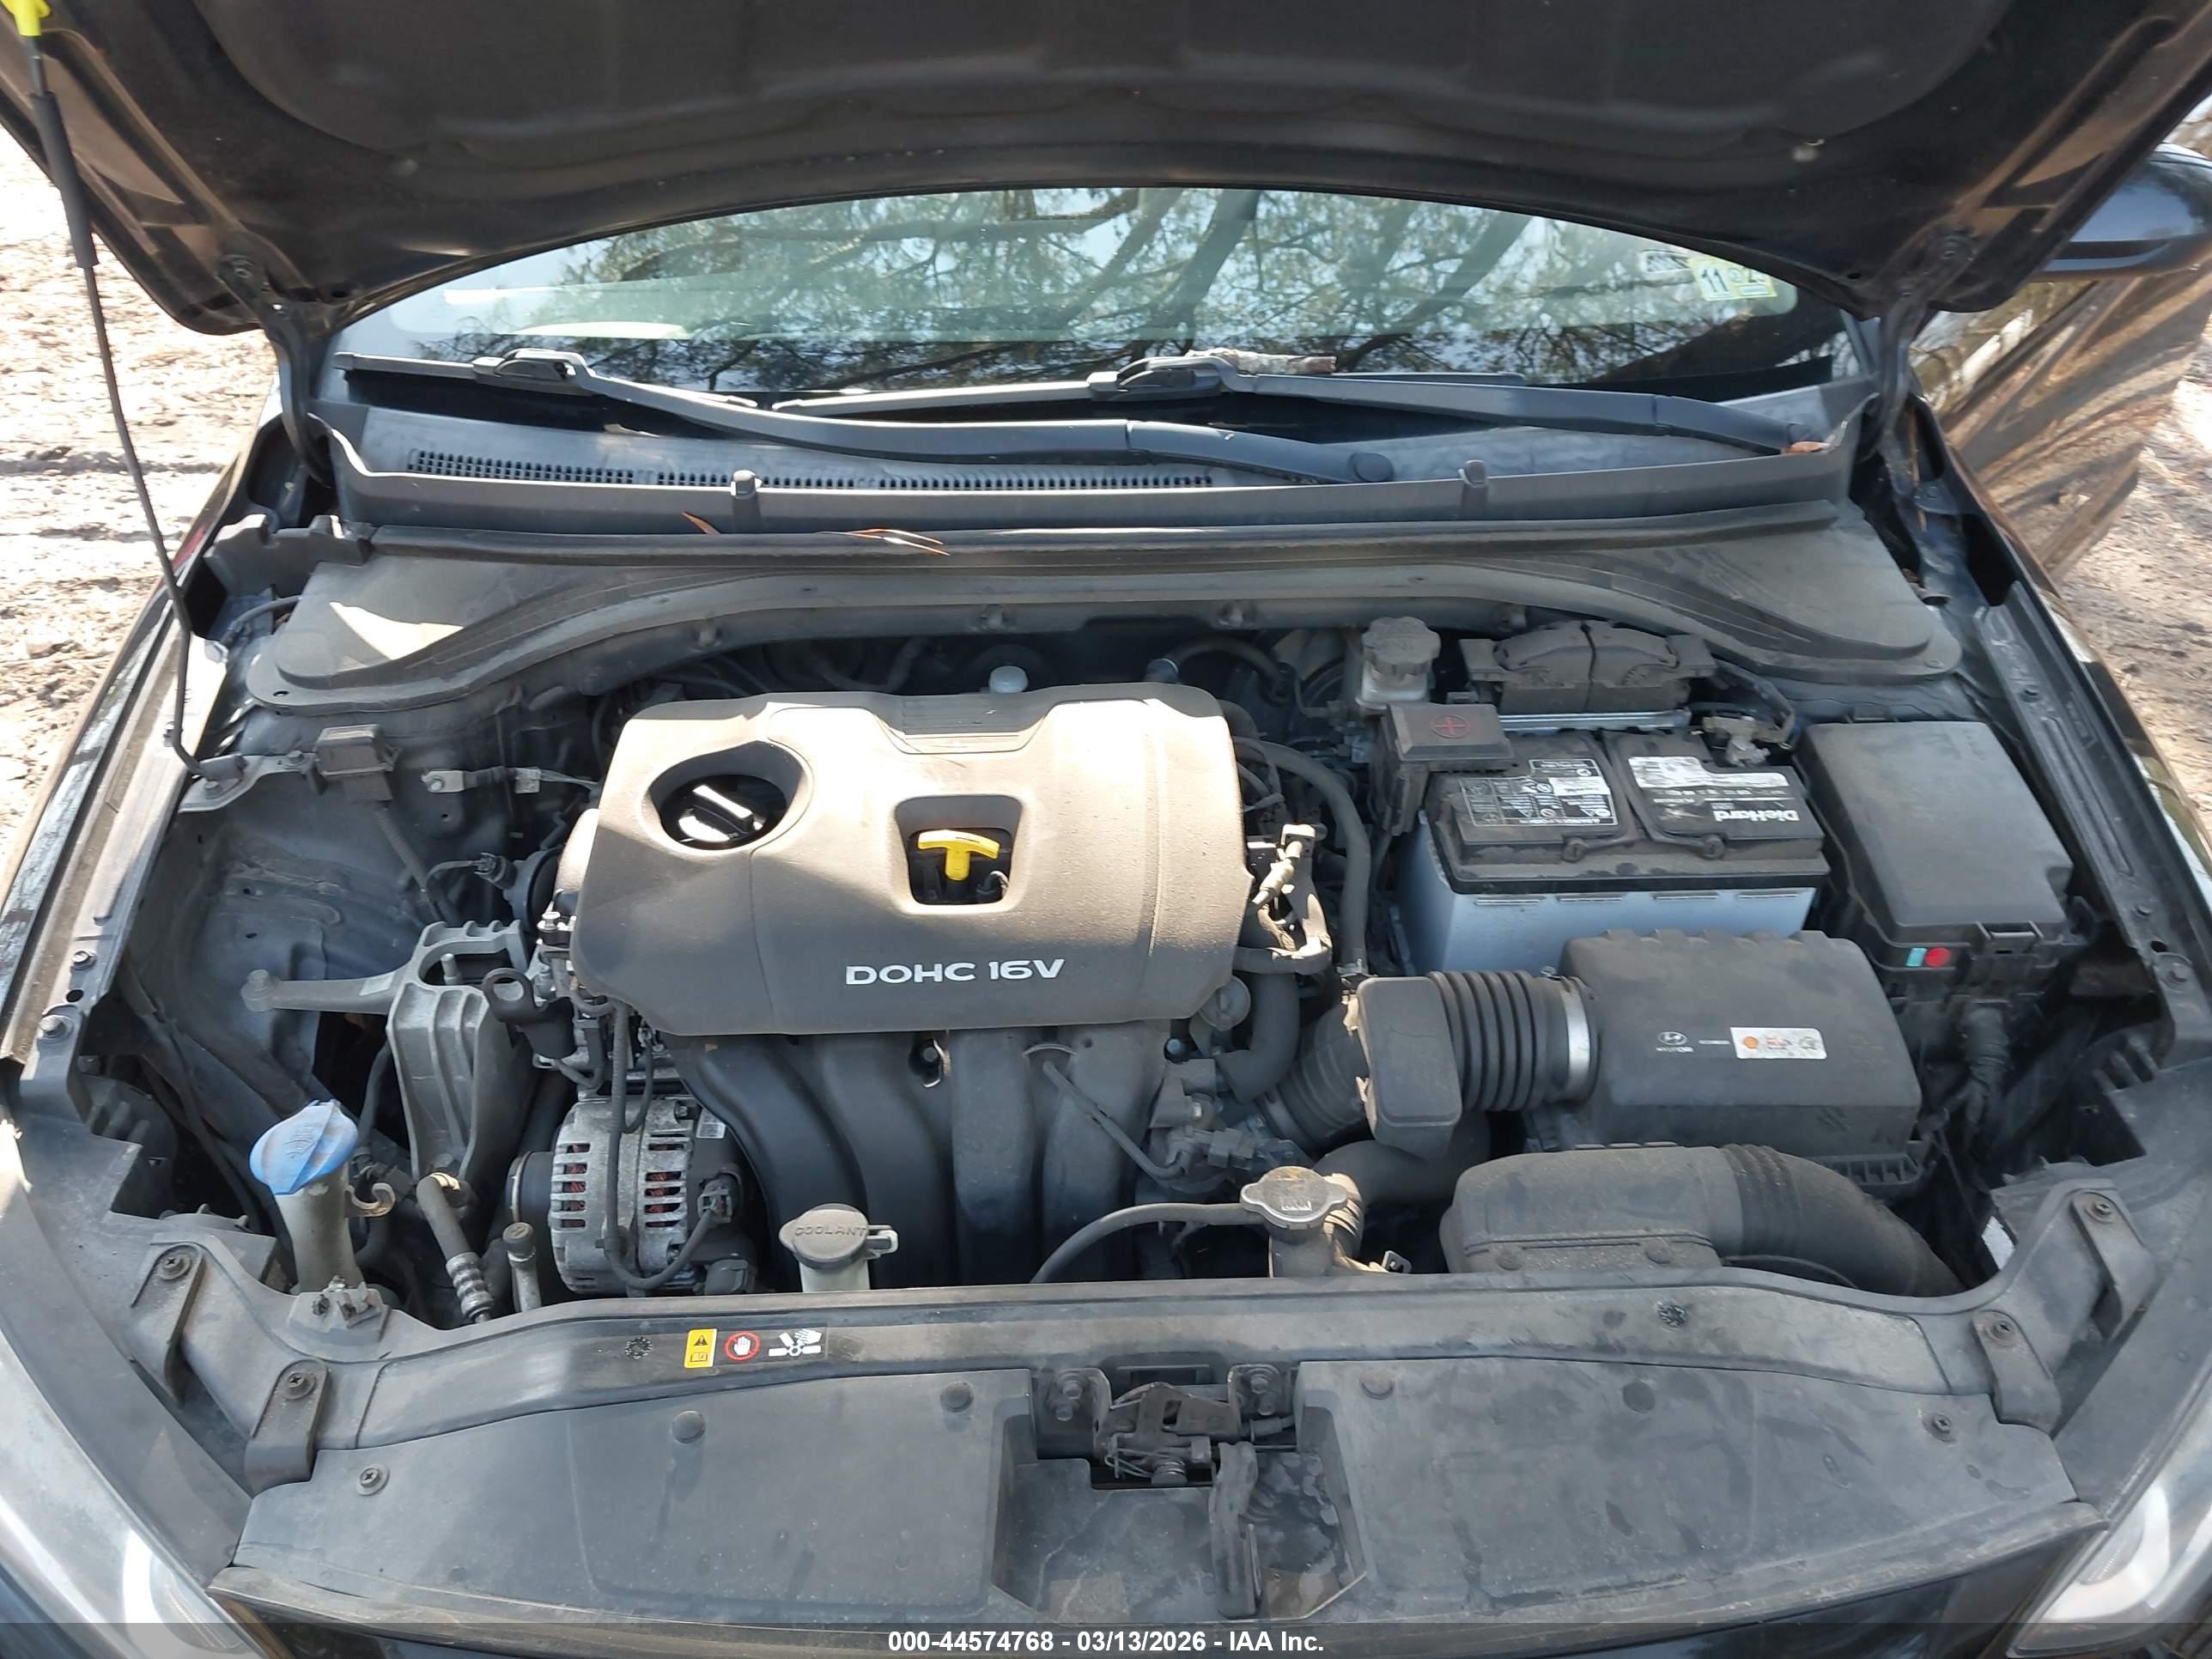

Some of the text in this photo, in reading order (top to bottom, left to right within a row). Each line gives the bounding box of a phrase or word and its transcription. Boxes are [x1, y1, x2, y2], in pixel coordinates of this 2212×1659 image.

[1701, 268, 1729, 293] 11
[1713, 810, 1800, 822] DieHard
[845, 958, 1065, 986] DOHC 16V
[794, 1224, 867, 1237] COOLANT
